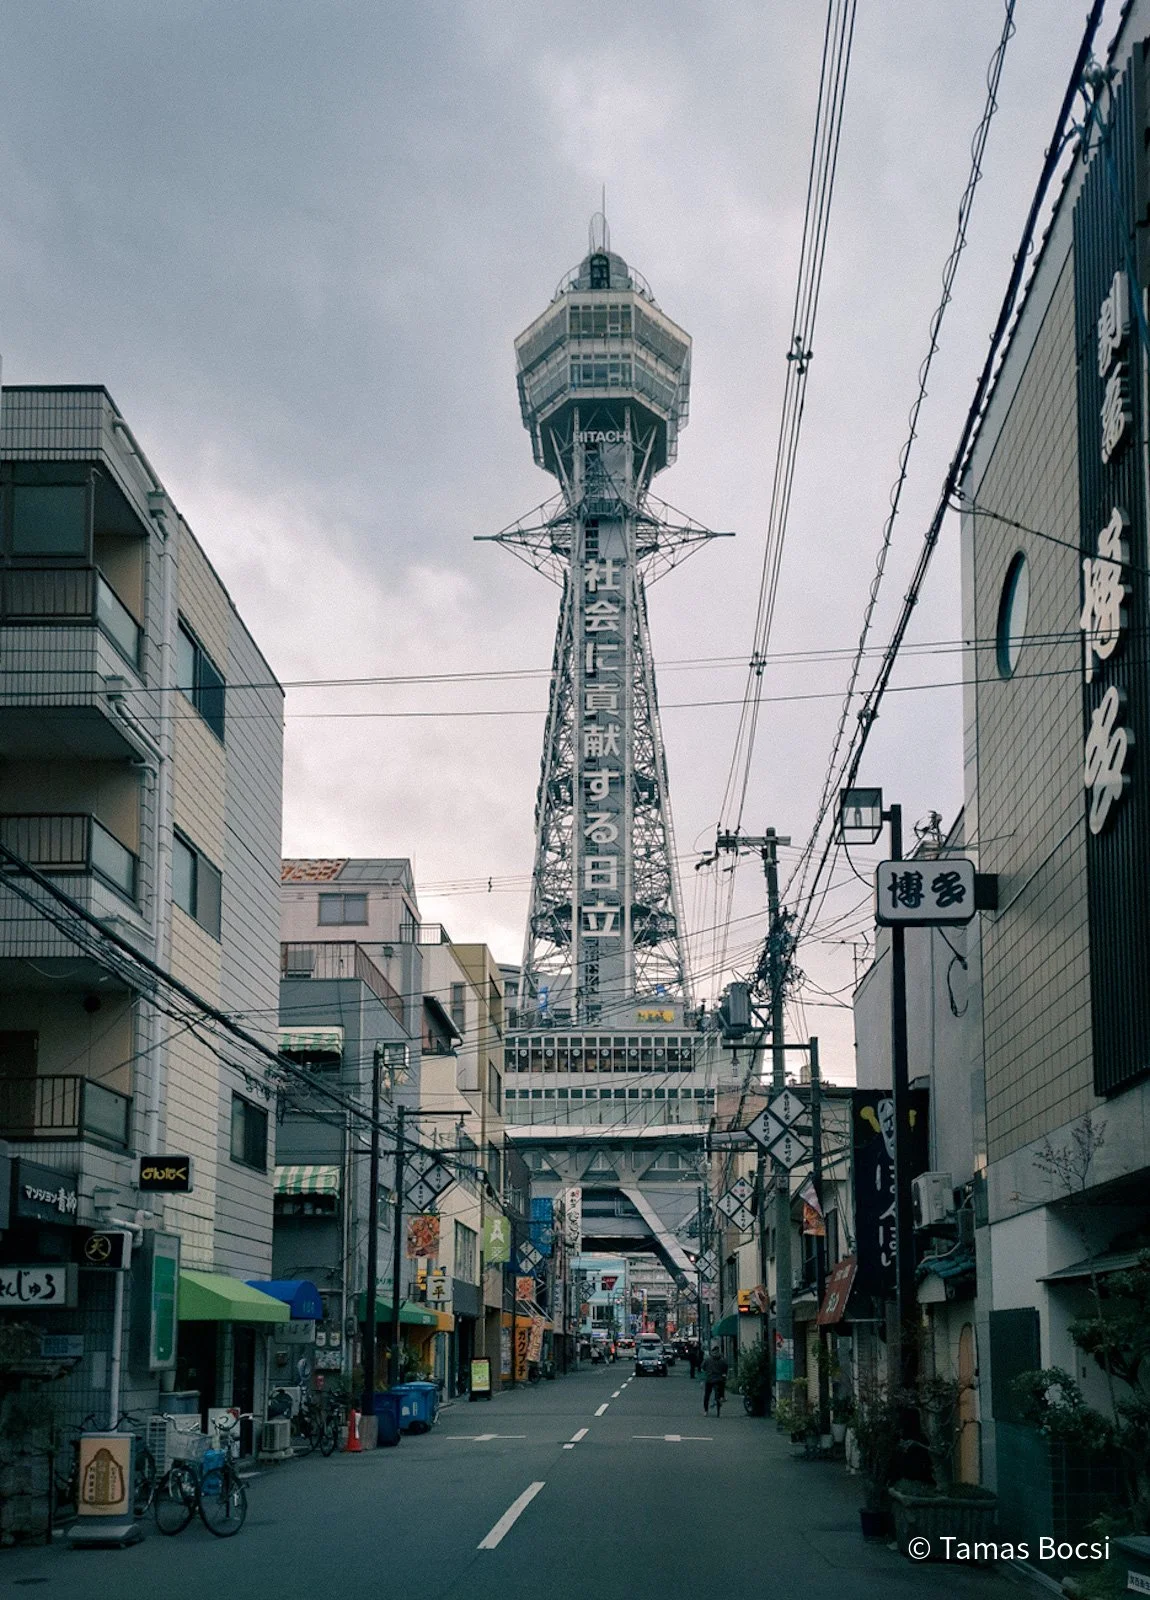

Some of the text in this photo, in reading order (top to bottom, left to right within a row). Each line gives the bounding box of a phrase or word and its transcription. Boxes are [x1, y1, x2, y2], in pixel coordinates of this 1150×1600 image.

[573, 429, 631, 444] HITACHI
[581, 558, 621, 937] 社会に貢献する日立
[887, 870, 966, 909] 博多
[432, 1278, 446, 1299] 一平
